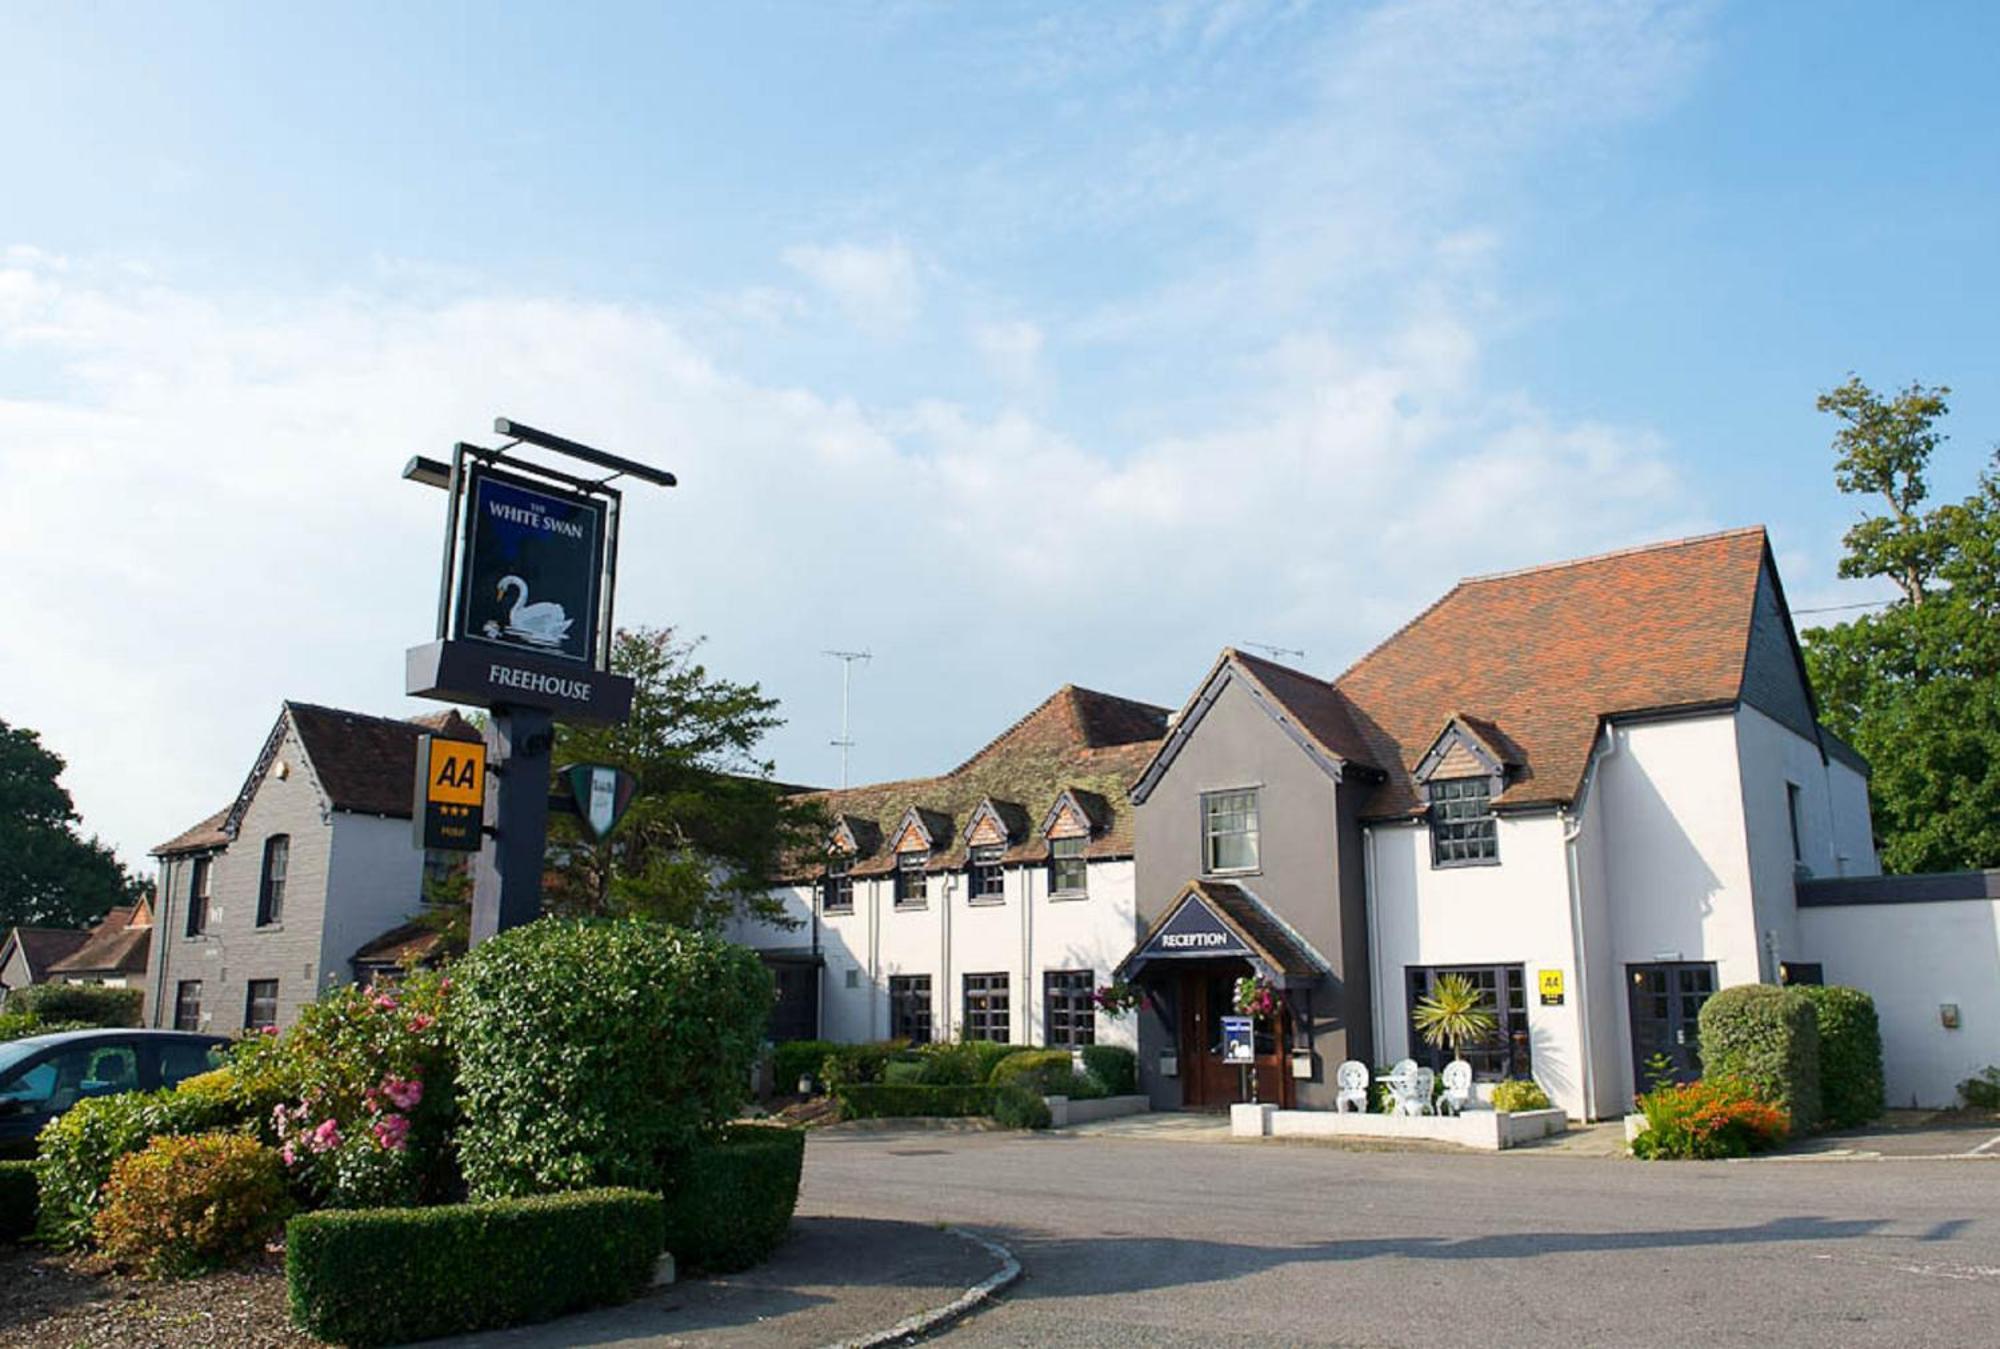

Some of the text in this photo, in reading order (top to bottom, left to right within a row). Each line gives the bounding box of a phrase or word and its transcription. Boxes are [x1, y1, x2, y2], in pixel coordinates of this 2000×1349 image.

[489, 500, 584, 539] WHITE SWAN
[489, 665, 591, 701] FREEHOUSE
[435, 755, 475, 790] AA
[1162, 932, 1227, 948] RECEPTION
